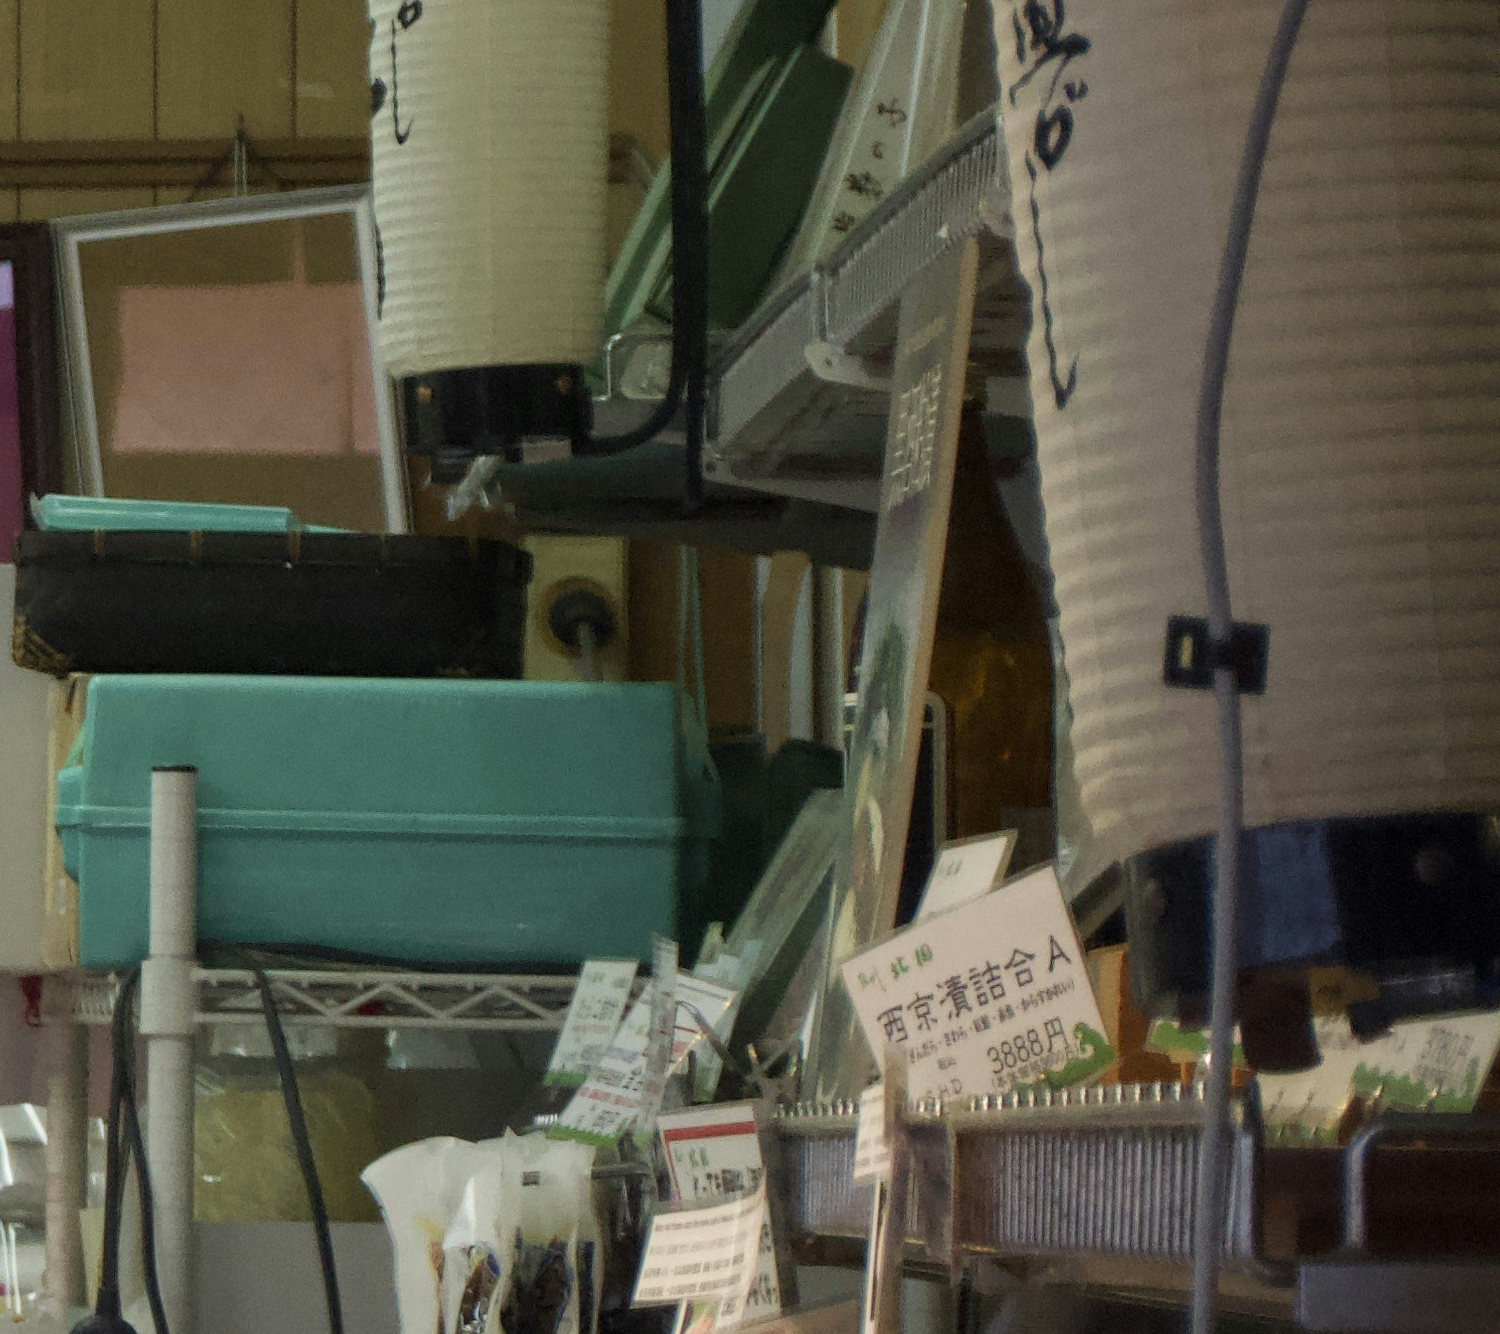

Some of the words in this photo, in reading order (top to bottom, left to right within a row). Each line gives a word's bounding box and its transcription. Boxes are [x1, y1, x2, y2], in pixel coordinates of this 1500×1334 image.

[877, 947, 1036, 1044] 西京漬詰合
[1049, 934, 1072, 973] A
[986, 1016, 1069, 1075] 3888円
